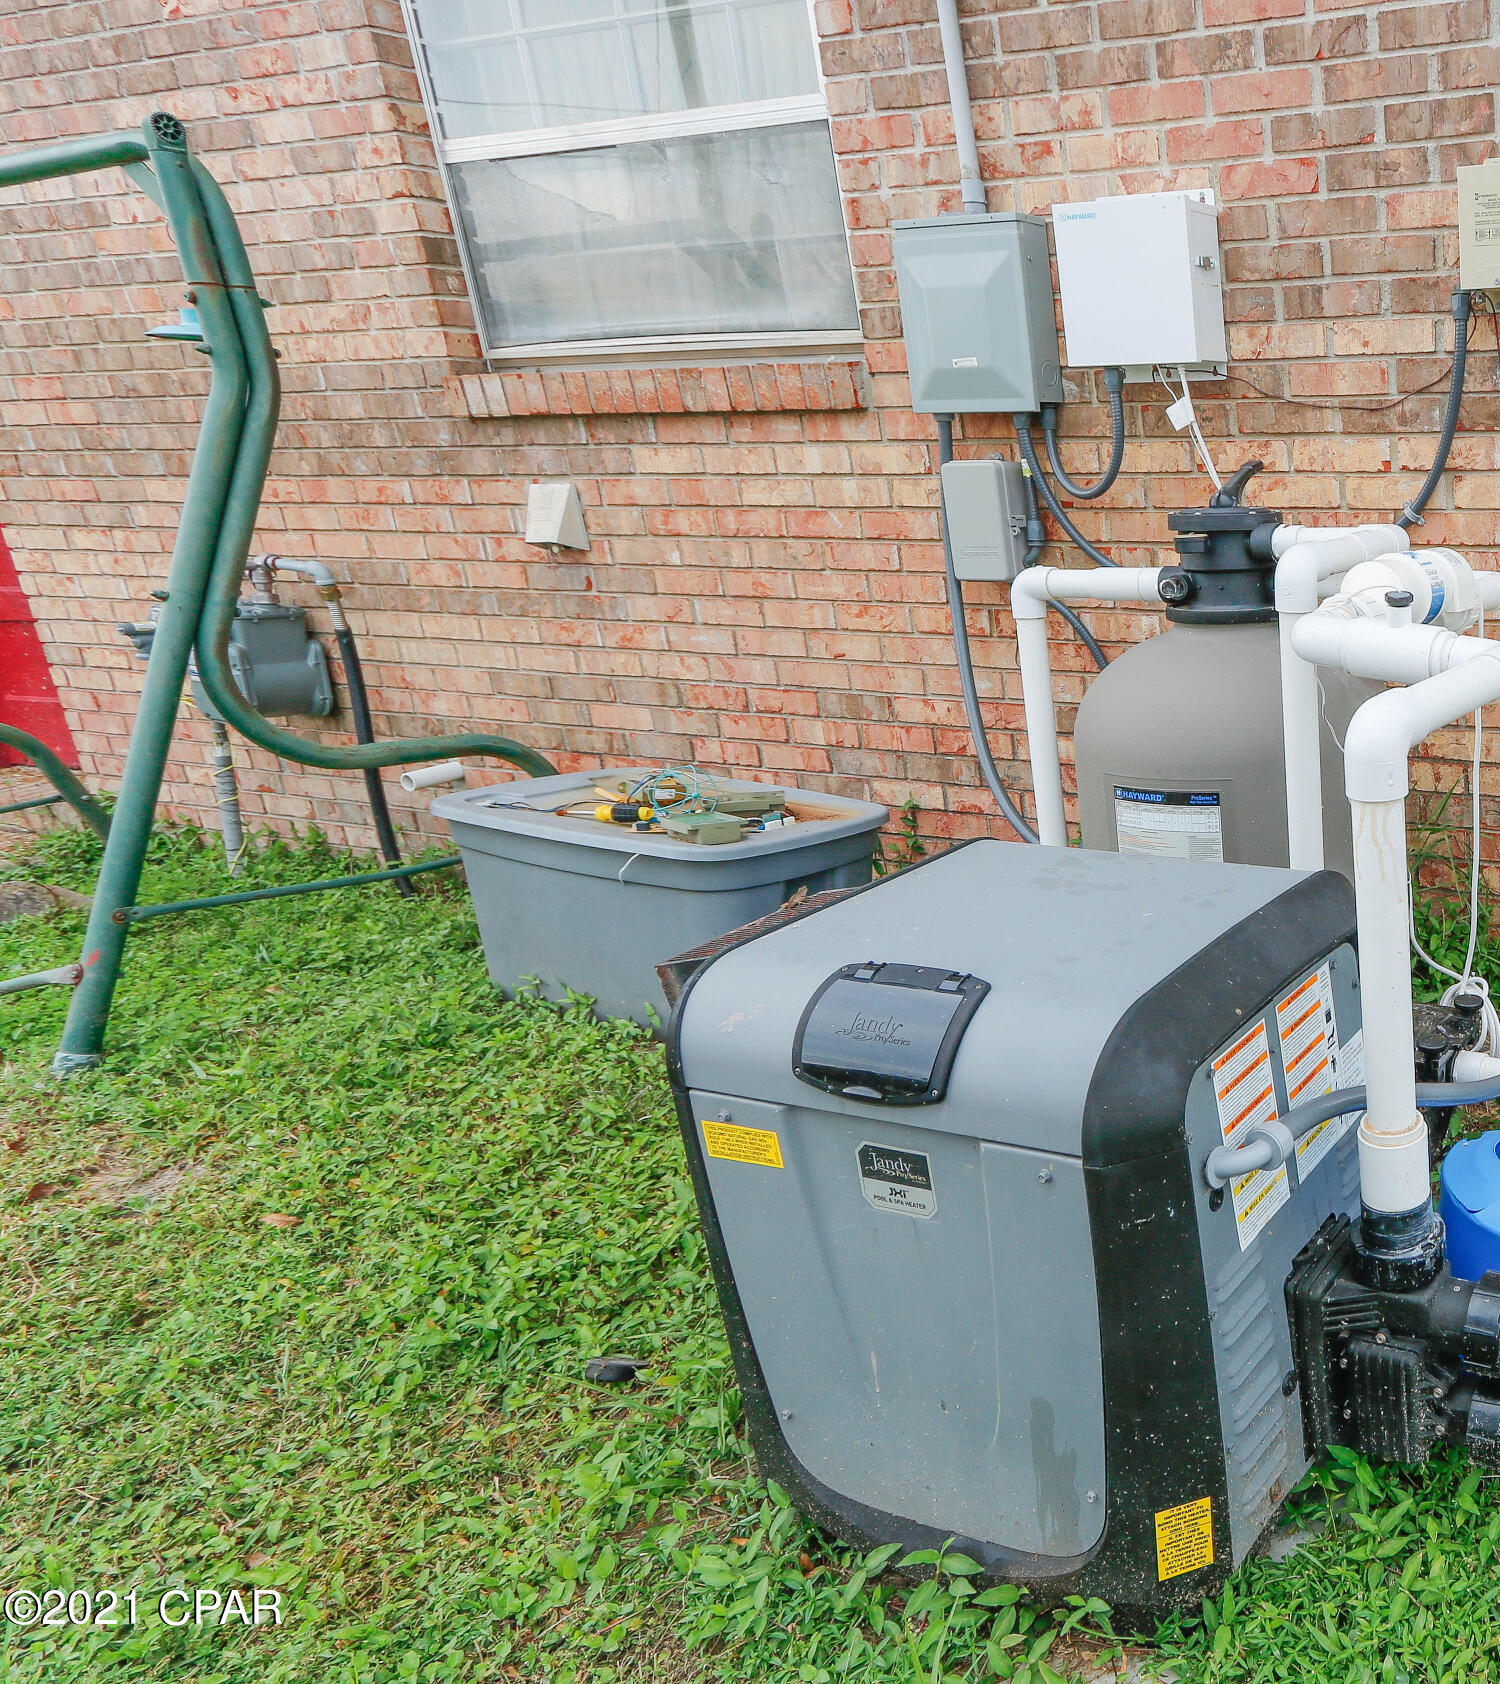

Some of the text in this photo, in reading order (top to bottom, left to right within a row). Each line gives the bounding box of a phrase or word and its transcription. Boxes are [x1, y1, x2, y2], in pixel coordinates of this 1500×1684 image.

[1122, 790, 1164, 802] HAYWARD
[847, 1011, 904, 1038] Jandy
[866, 1152, 911, 1172] Jandy
[873, 1194, 888, 1203] POOL
[905, 1201, 927, 1210] HEATER
[1164, 1508, 1194, 1519] IMPORTANT
[1161, 1522, 1181, 1531] ATTACH
[1165, 1534, 1195, 1546] IMPORTANT
